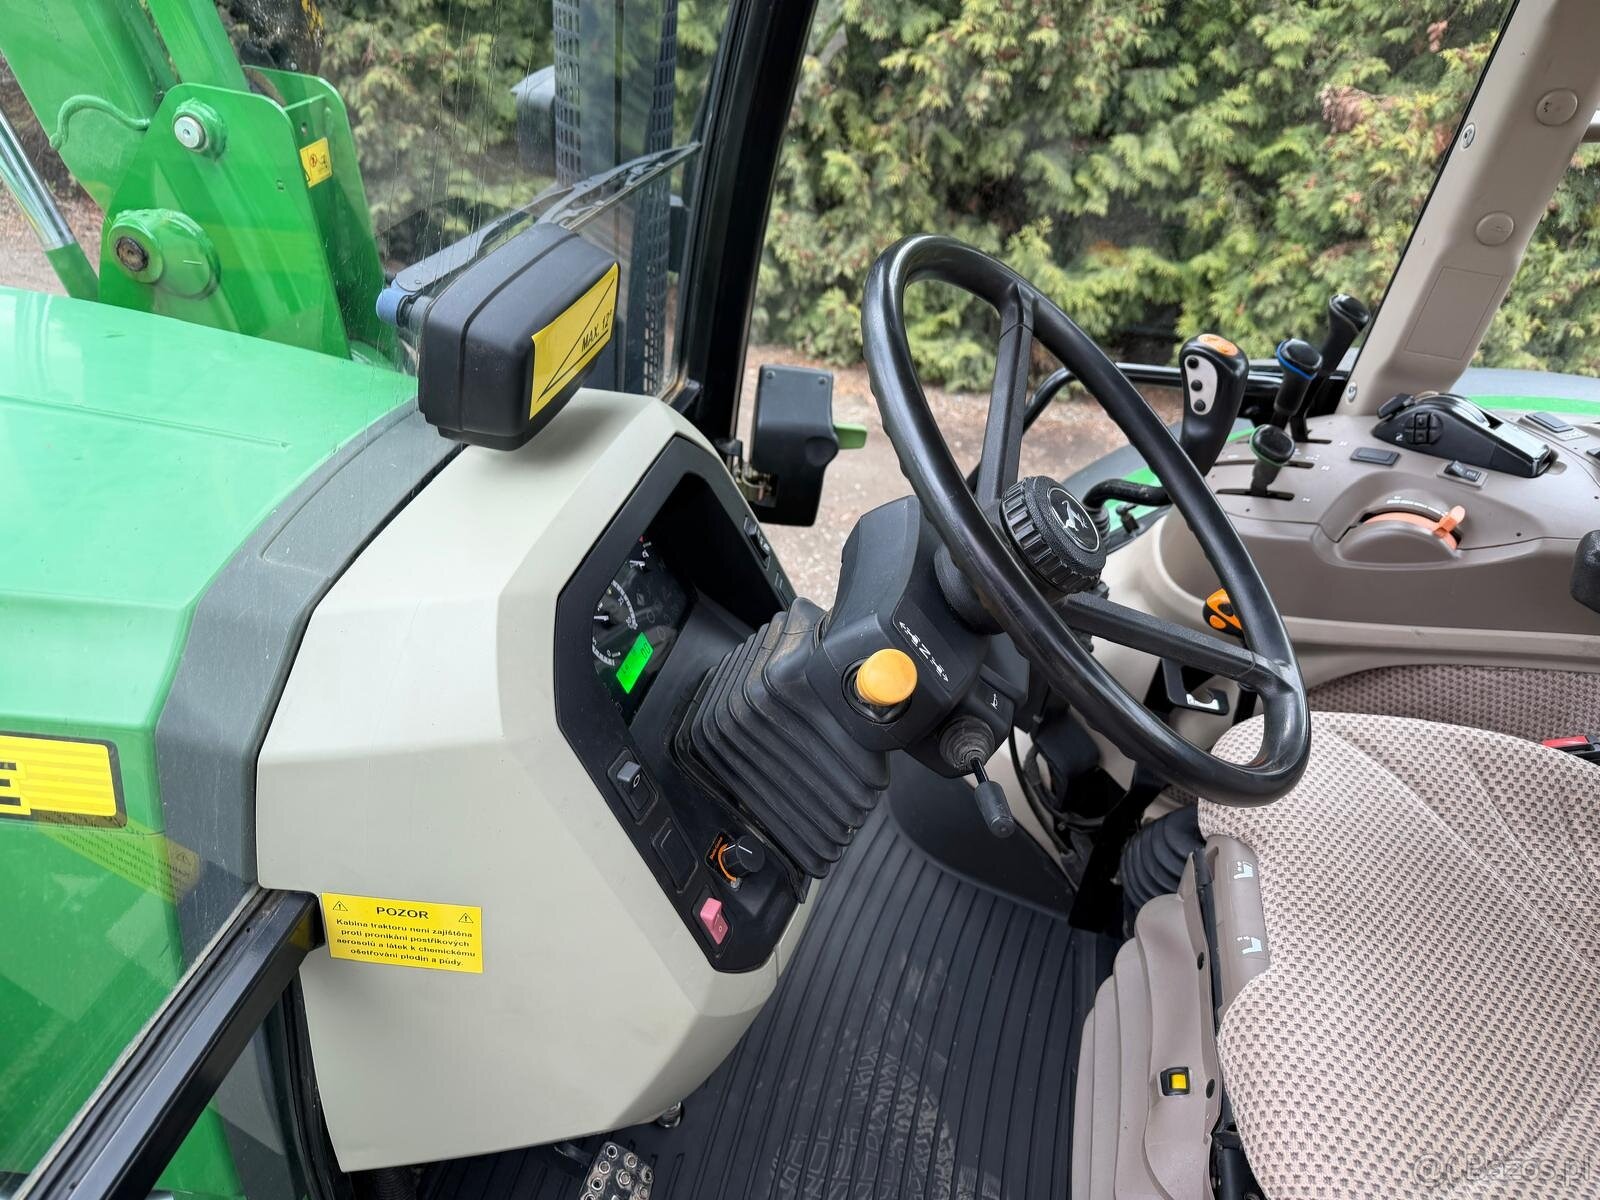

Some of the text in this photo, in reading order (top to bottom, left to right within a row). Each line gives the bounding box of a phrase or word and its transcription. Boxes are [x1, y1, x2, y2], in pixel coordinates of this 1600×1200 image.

[581, 323, 600, 352] MAX.
[376, 906, 430, 919] POZOR
[336, 918, 368, 928] Kabina
[371, 922, 407, 931] traktoru
[432, 929, 473, 938] zajištěna
[341, 929, 470, 947] proti pronikání postřikových
[350, 948, 398, 958] ošetřování
[400, 954, 429, 963] plodin
[418, 946, 476, 957] chemickému
